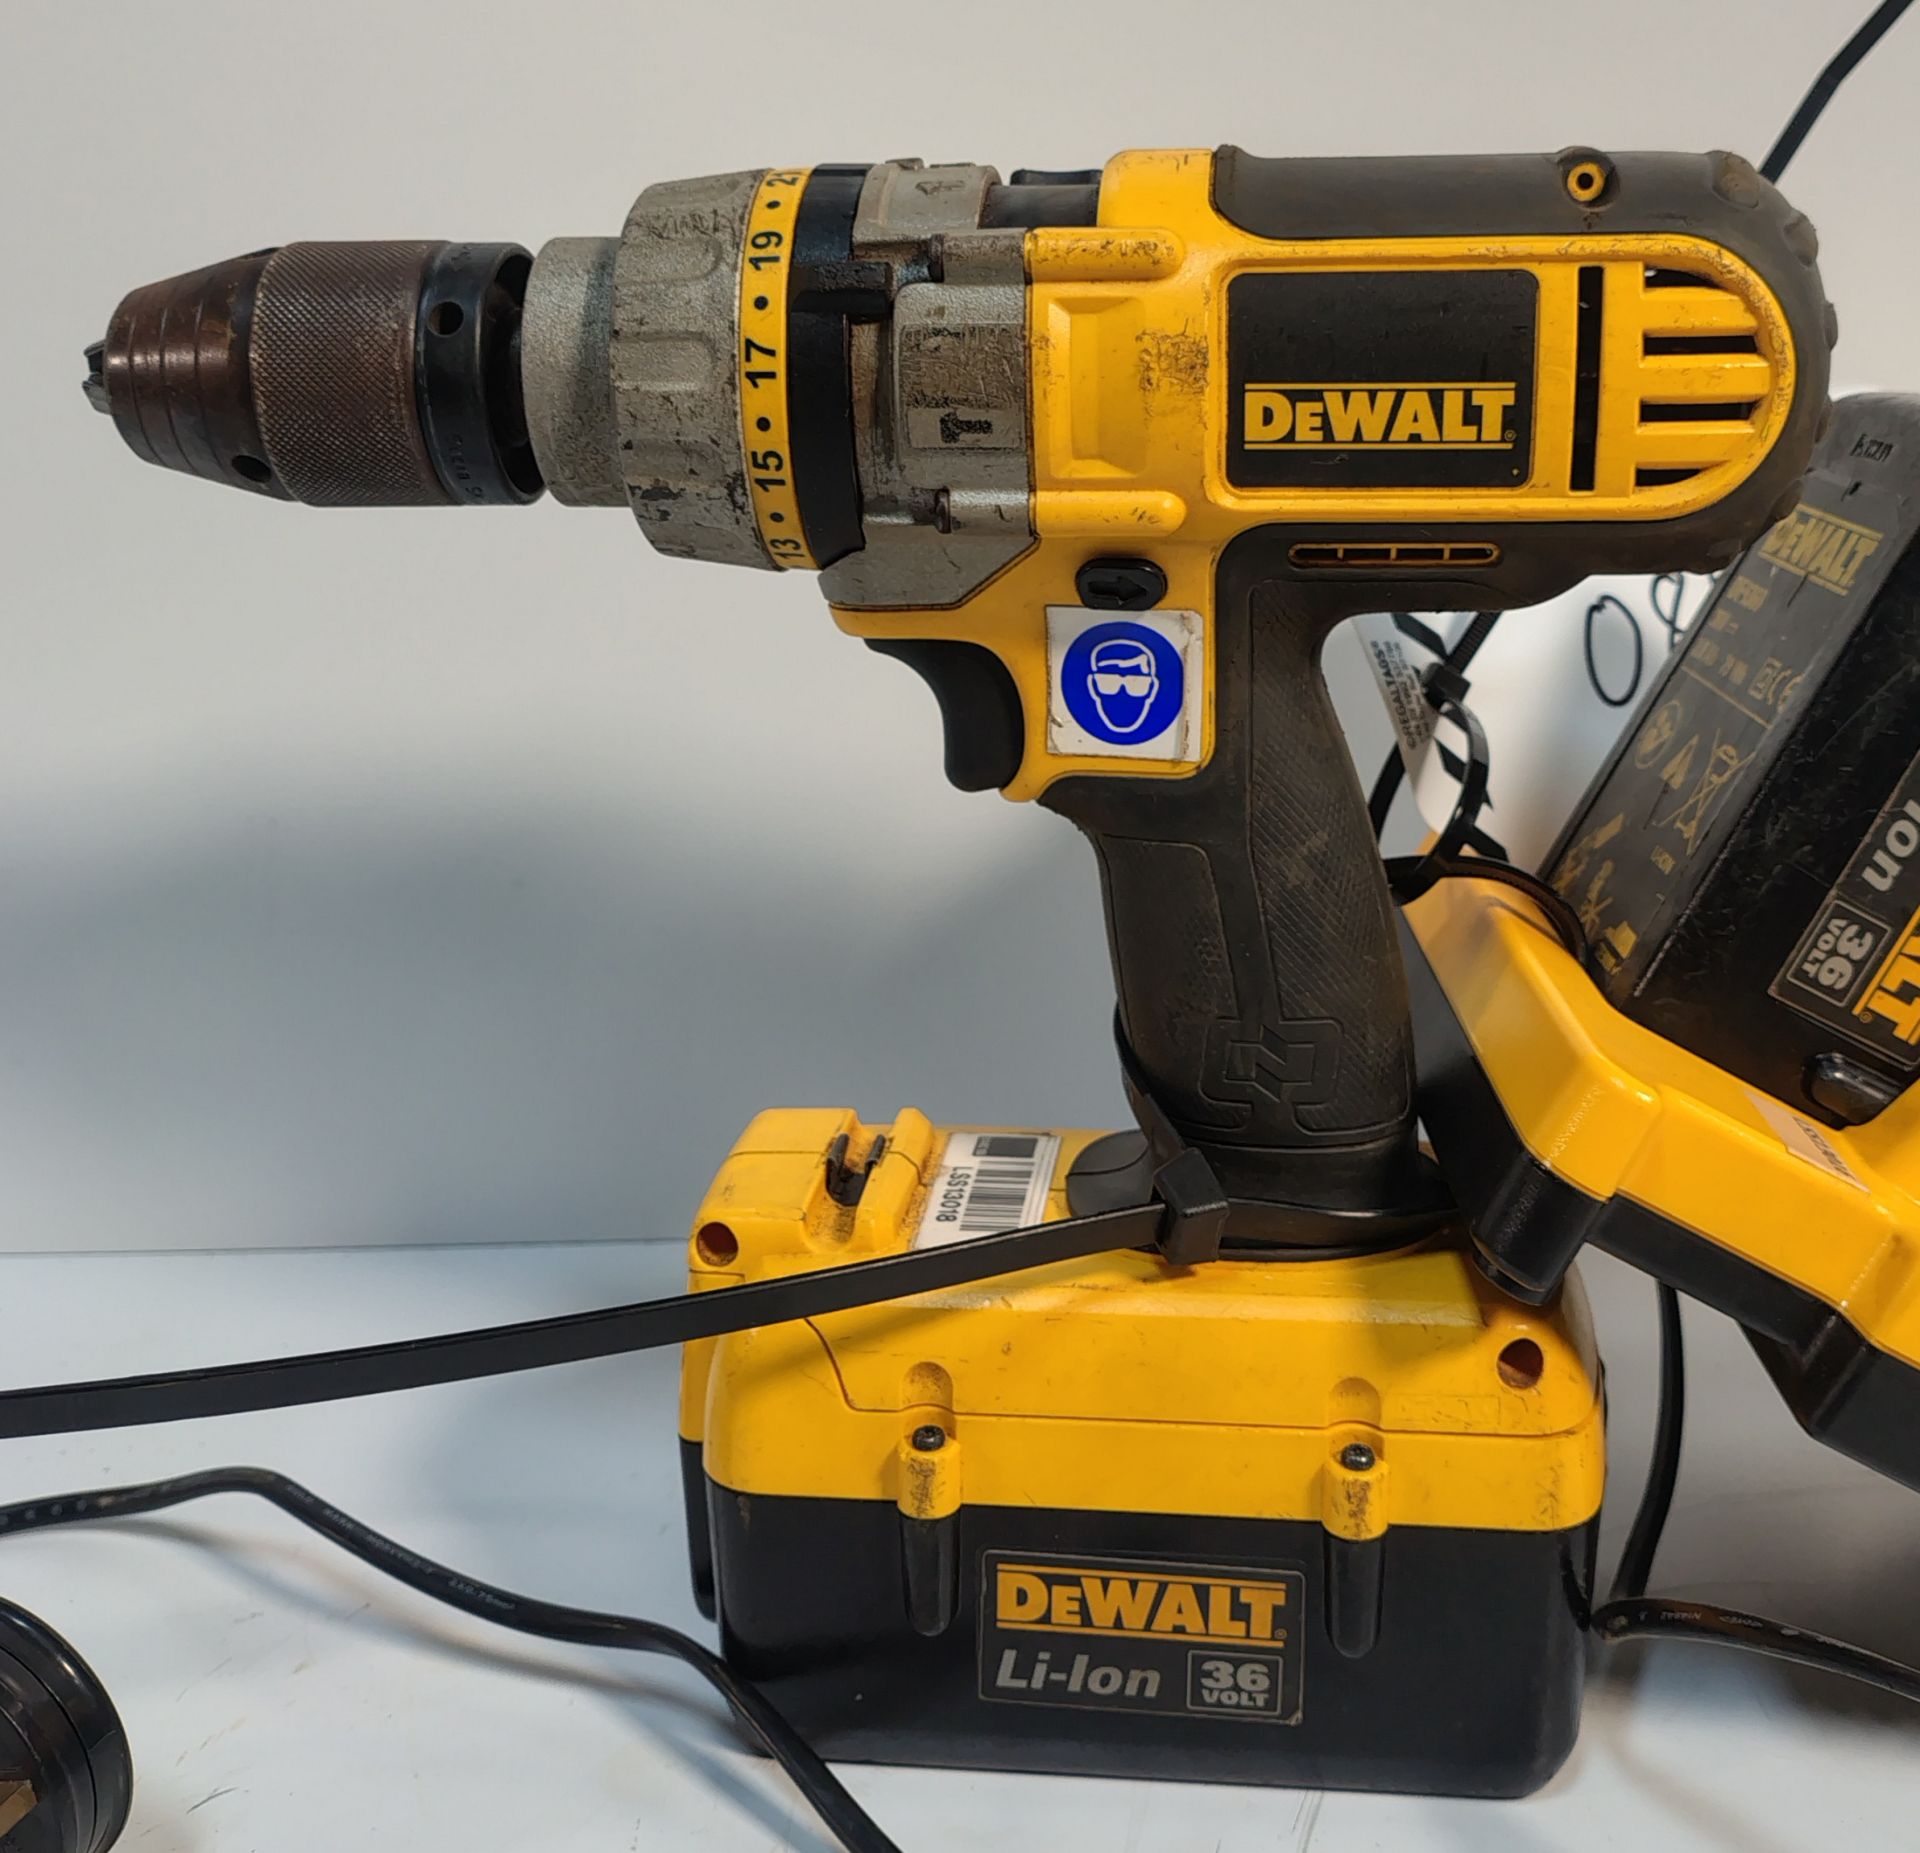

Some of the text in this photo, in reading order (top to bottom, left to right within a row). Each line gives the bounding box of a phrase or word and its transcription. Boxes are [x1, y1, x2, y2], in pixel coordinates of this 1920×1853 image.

[749, 230, 783, 271] 19
[745, 338, 777, 388] 17
[1244, 389, 1515, 442] DEWALT
[751, 449, 786, 492] 15
[773, 538, 801, 561] 13
[1801, 918, 1849, 979] VOLT
[1817, 924, 1874, 990] 36
[1866, 935, 1920, 1042] LT
[936, 1166, 974, 1223] LSS13018
[997, 1571, 1286, 1640] DEWALT
[996, 1649, 1161, 1698] Li-Ion
[1200, 1660, 1271, 1692] 36
[1201, 1689, 1269, 1708] VOLT
